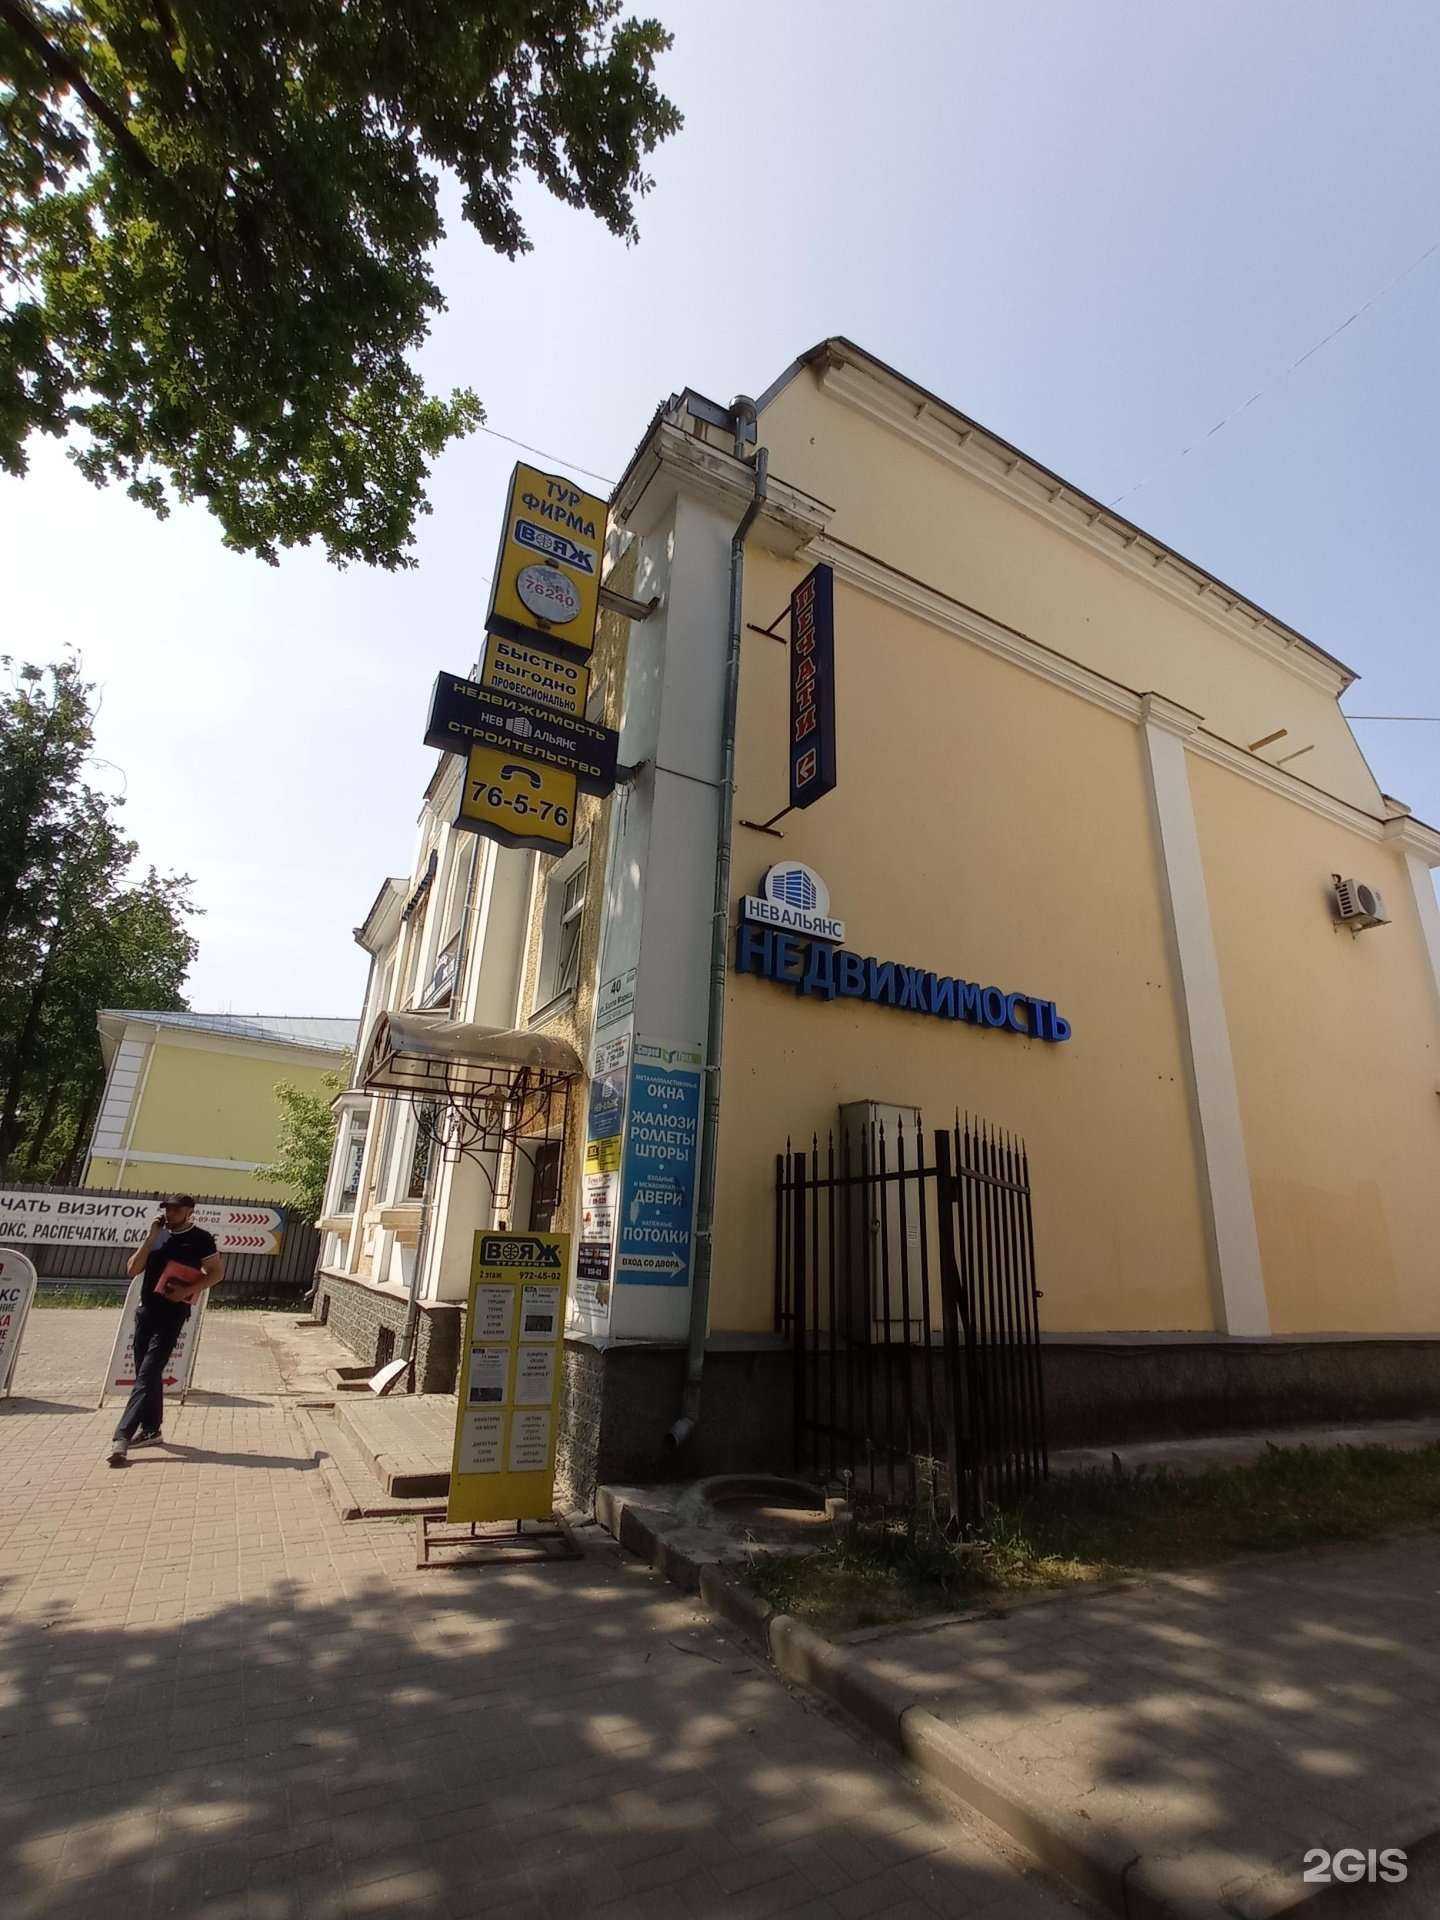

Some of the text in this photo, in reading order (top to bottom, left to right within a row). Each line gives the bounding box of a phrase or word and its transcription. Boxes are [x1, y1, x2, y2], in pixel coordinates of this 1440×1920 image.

[546, 480, 581, 506] ТУР
[522, 493, 596, 539] ФИРМА
[525, 579, 575, 607] 76240
[496, 643, 578, 680] БЫСТРО
[494, 660, 576, 695] ВЫГОДНО
[491, 675, 576, 712] ПРОФЕССИОНАЛЬНО
[453, 683, 607, 741] НЕДВИЖИМОСТЬ
[481, 711, 577, 751] НЕВ АЛЬЯНС
[448, 720, 601, 776] СТРОИТЕЛЬСТВО
[471, 781, 569, 826] 76-5-76
[610, 979, 622, 994] 40
[736, 924, 1072, 1042] НЕДВИЖИМОСТЬ
[647, 1084, 685, 1101] ОКНА
[631, 1110, 696, 1129] ЖАЛЮЗИ
[631, 1126, 695, 1146] РОЛЛЕТЫ
[635, 1143, 689, 1161] ШТОРЫ
[0, 1198, 148, 1218] ЧАТЬ ВИЗИТОК
[634, 1189, 682, 1205] ДВЕРИ
[33, 1224, 118, 1243] РАСПЕЧАТКИ,
[623, 1227, 689, 1244] ПОТОЛКИ
[622, 1257, 680, 1268] ВХОД СО ДВОРА
